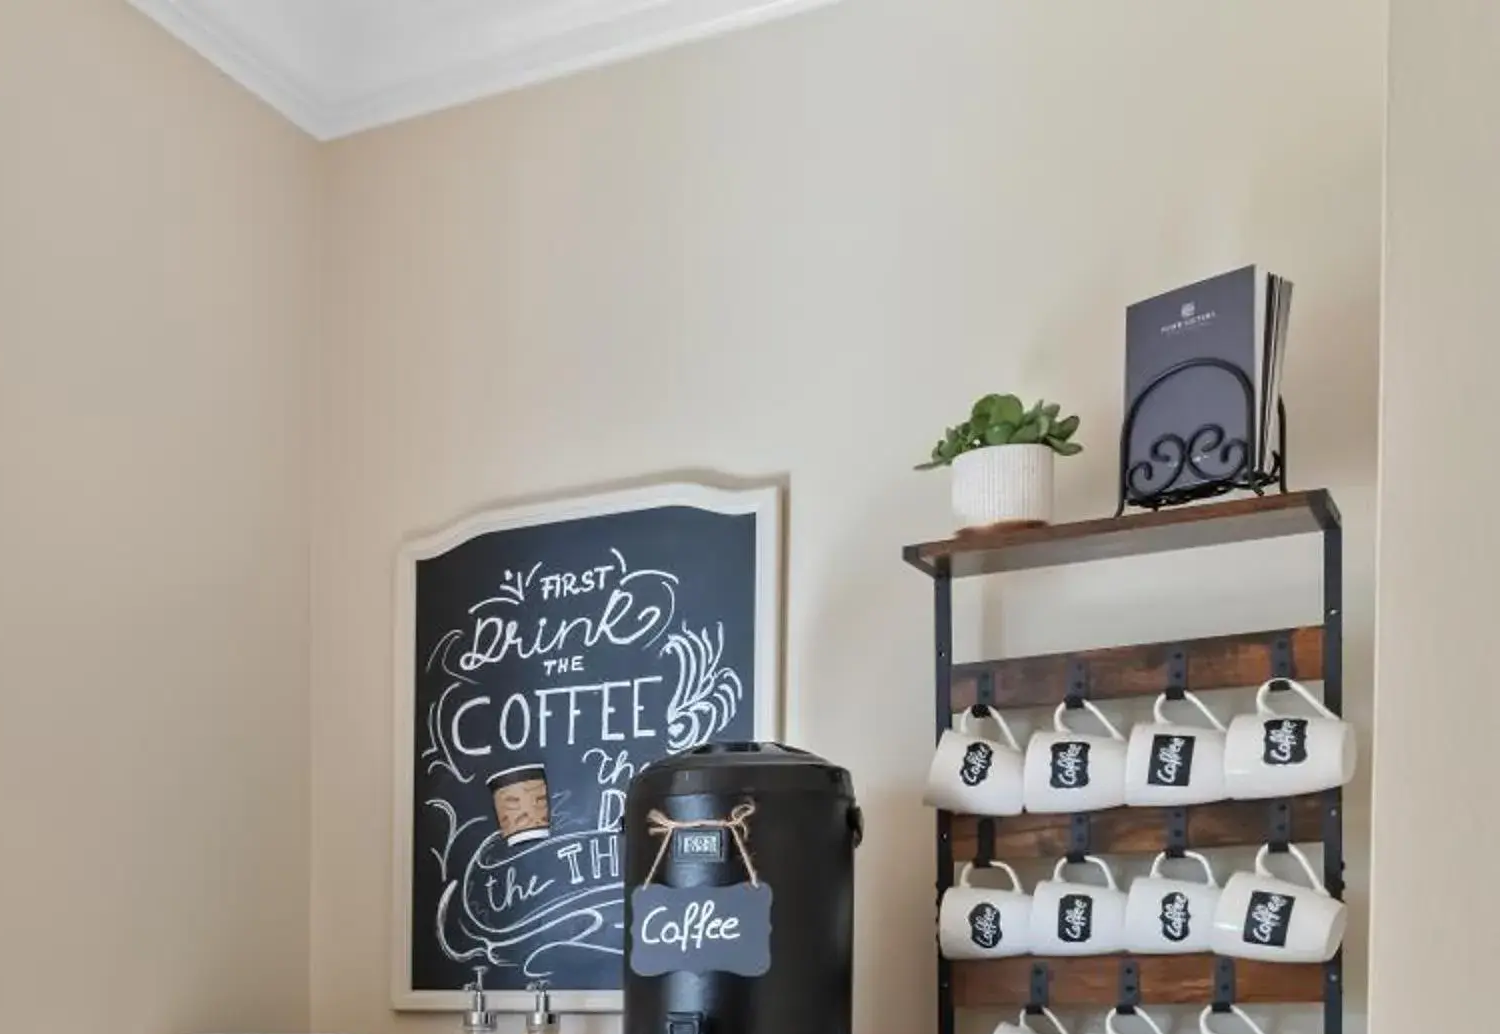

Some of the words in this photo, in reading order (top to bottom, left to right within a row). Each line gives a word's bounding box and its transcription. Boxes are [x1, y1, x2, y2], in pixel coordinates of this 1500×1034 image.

[540, 565, 613, 599] FIRST
[460, 589, 660, 671] Drink
[543, 654, 585, 673] THE
[451, 675, 663, 756] COFFEE
[1156, 737, 1186, 783] Coffee
[1269, 719, 1297, 762] Coffee
[964, 745, 988, 782] Coffee
[1058, 743, 1083, 785] Coffee
[484, 871, 555, 912] the
[641, 900, 741, 951] Coffee
[1065, 899, 1087, 939] Coffee
[1164, 894, 1187, 937] Coffee
[1252, 895, 1287, 942] Coffee
